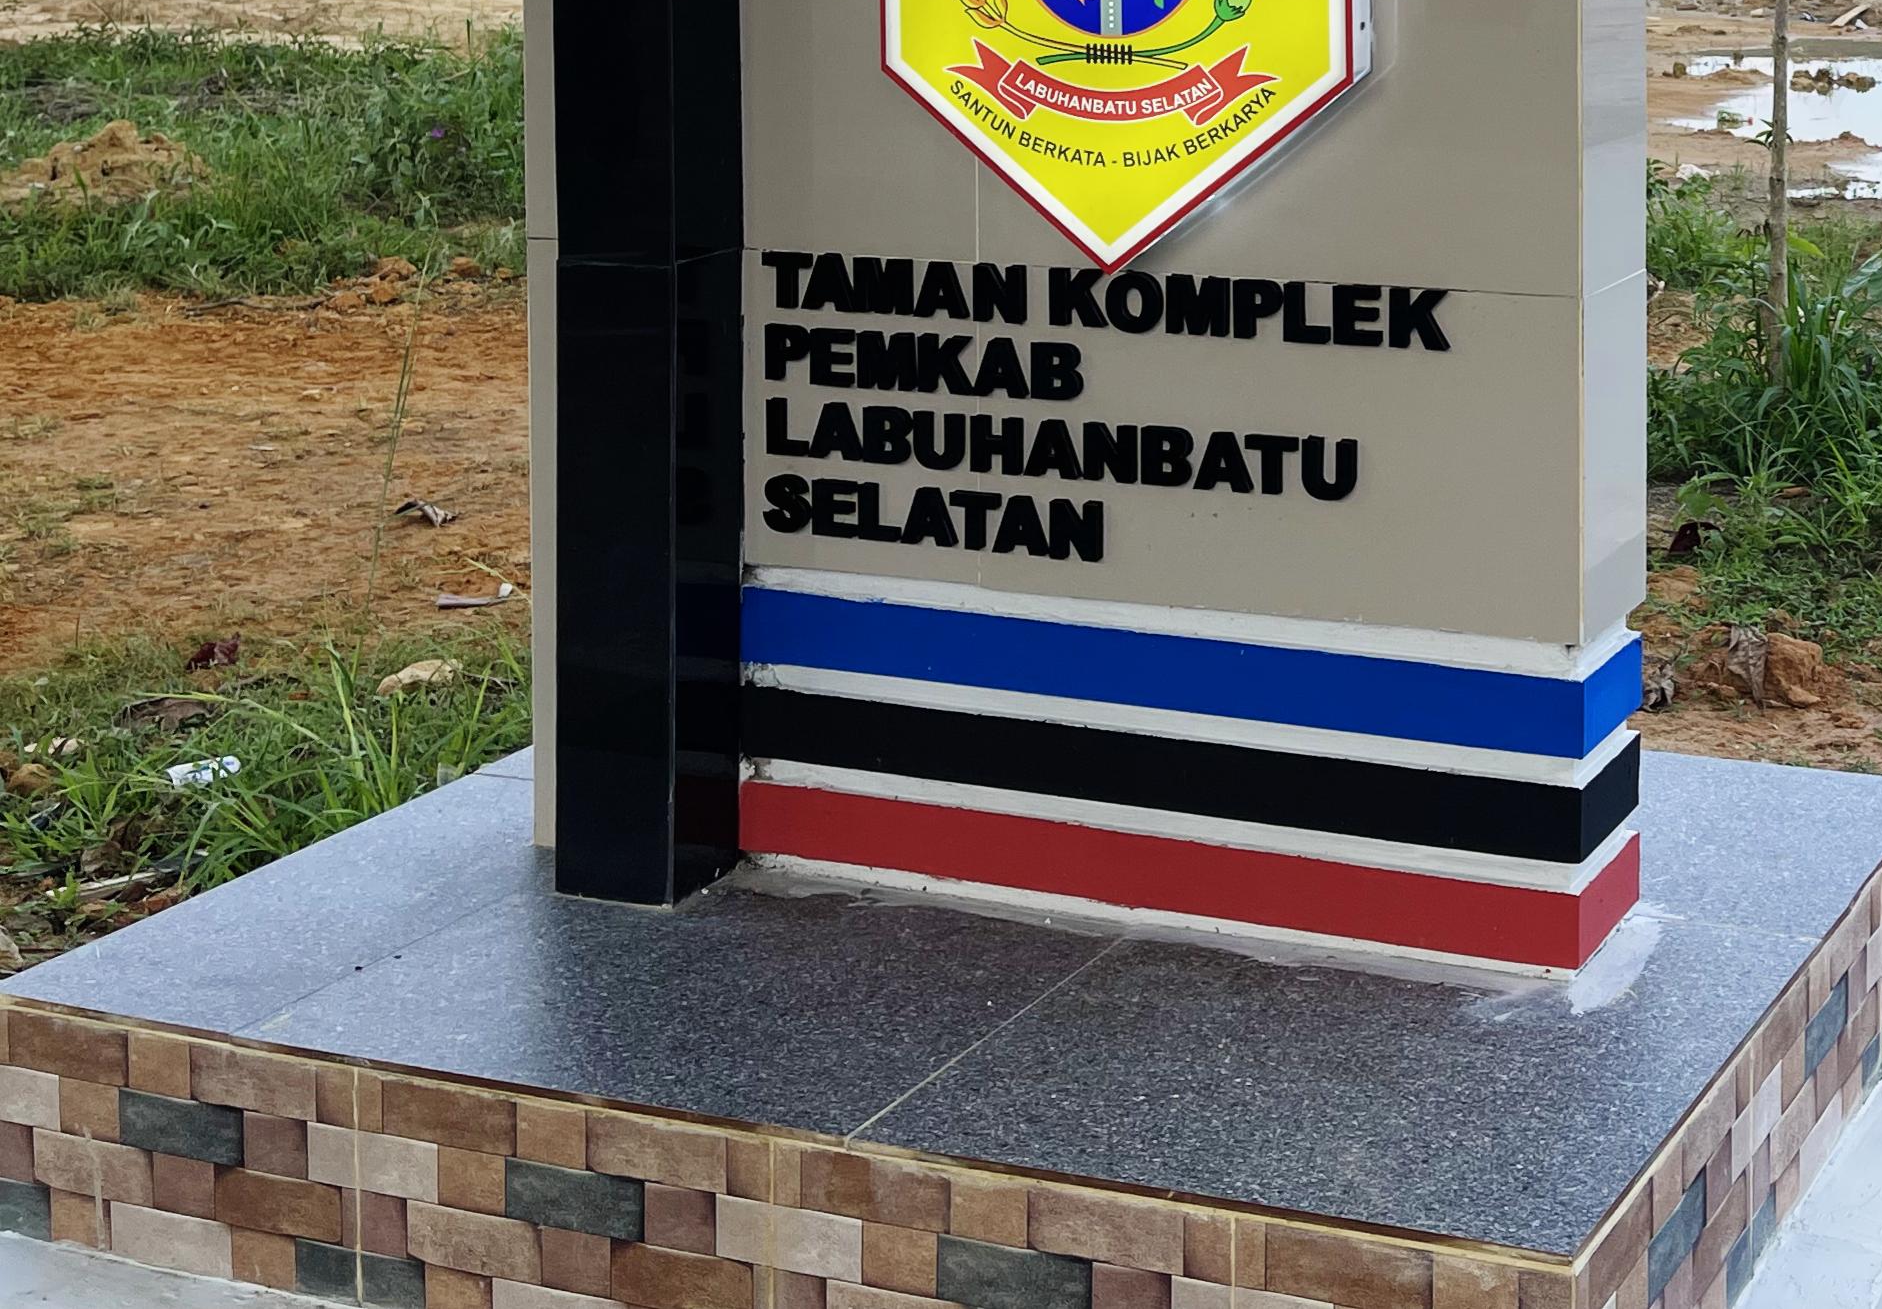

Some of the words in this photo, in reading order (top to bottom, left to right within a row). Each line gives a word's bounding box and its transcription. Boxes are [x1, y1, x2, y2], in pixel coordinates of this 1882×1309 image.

[950, 80, 1017, 140] SANTUN
[1018, 130, 1107, 168] BERKATA
[1123, 144, 1181, 168] BIJAK
[1183, 88, 1277, 156] BERKARYA
[1015, 72, 1137, 115] LABUHANBATU
[1141, 78, 1213, 114] SELATAN
[762, 251, 1028, 325] TAMAN
[1049, 267, 1452, 352] KOMPLEK
[764, 323, 1084, 401] PEMKAB
[765, 398, 1358, 501] LABUHANBATU
[762, 475, 1104, 563] SELATAN
